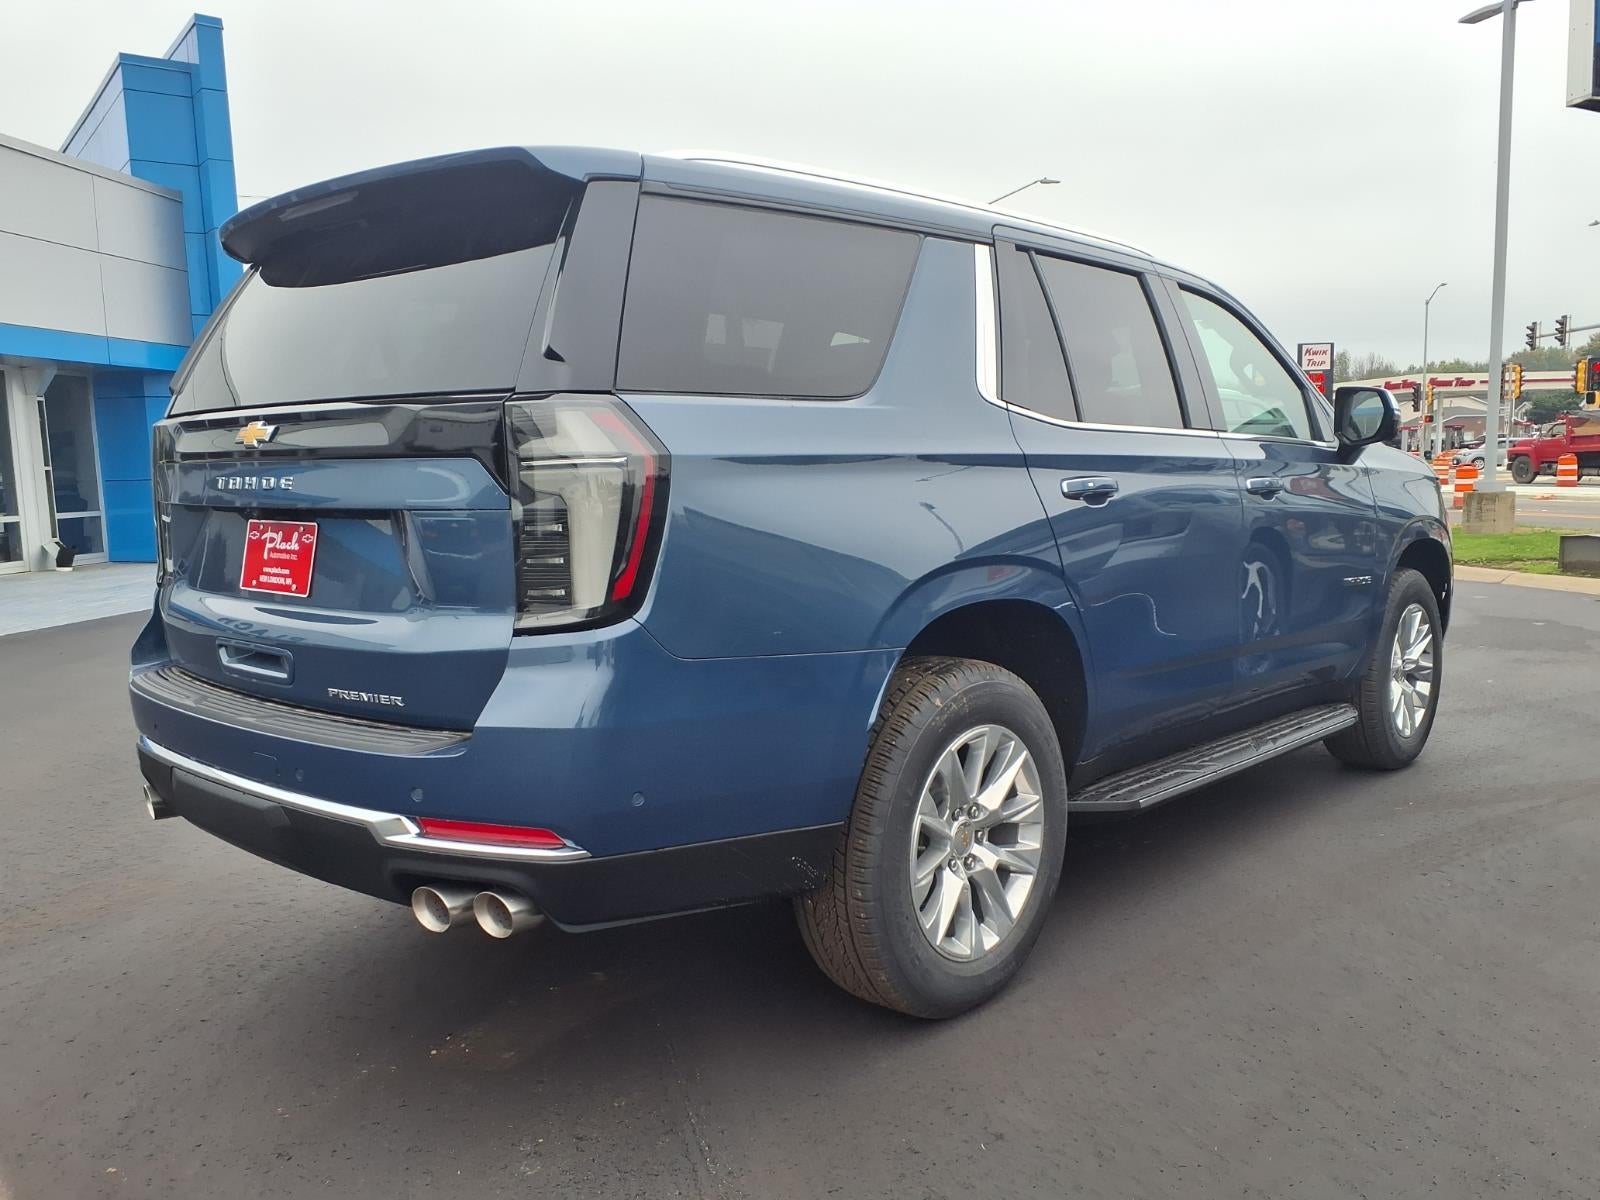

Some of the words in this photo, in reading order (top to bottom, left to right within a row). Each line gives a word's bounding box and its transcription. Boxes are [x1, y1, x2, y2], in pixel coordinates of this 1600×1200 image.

[1304, 347, 1328, 356] KWIK
[1306, 358, 1326, 367] TRIP
[216, 476, 294, 490] TAHOE
[261, 526, 300, 561] Plach
[327, 687, 406, 707] PREMIER
